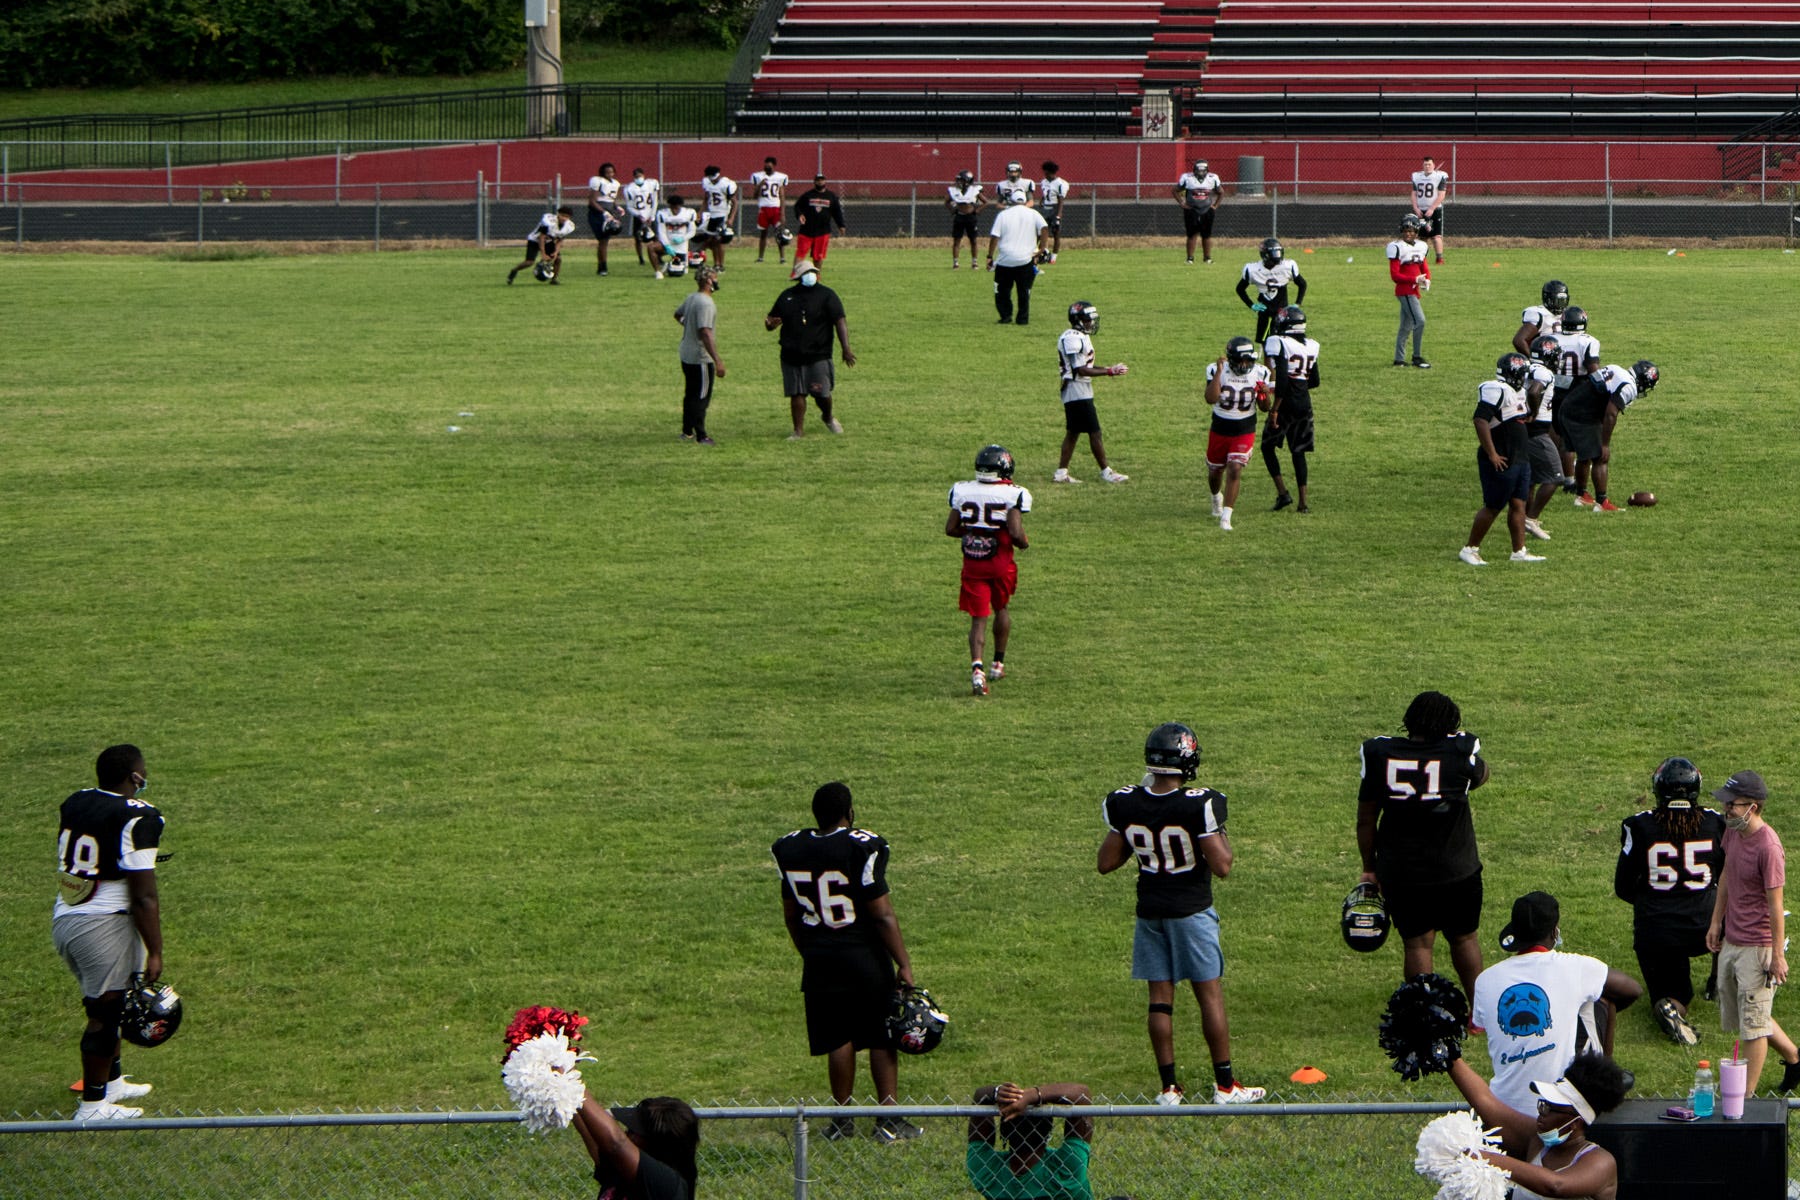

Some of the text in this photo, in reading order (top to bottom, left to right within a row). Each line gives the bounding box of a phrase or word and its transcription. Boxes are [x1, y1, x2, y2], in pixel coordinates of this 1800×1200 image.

[634, 193, 653, 210] 24
[761, 183, 779, 198] 20
[1417, 182, 1434, 198] 58
[1219, 385, 1257, 412] 30
[960, 501, 1008, 527] 25
[1386, 758, 1442, 800] 51
[1124, 824, 1197, 875] 80
[1647, 841, 1714, 891] 65
[785, 870, 857, 930] 56
